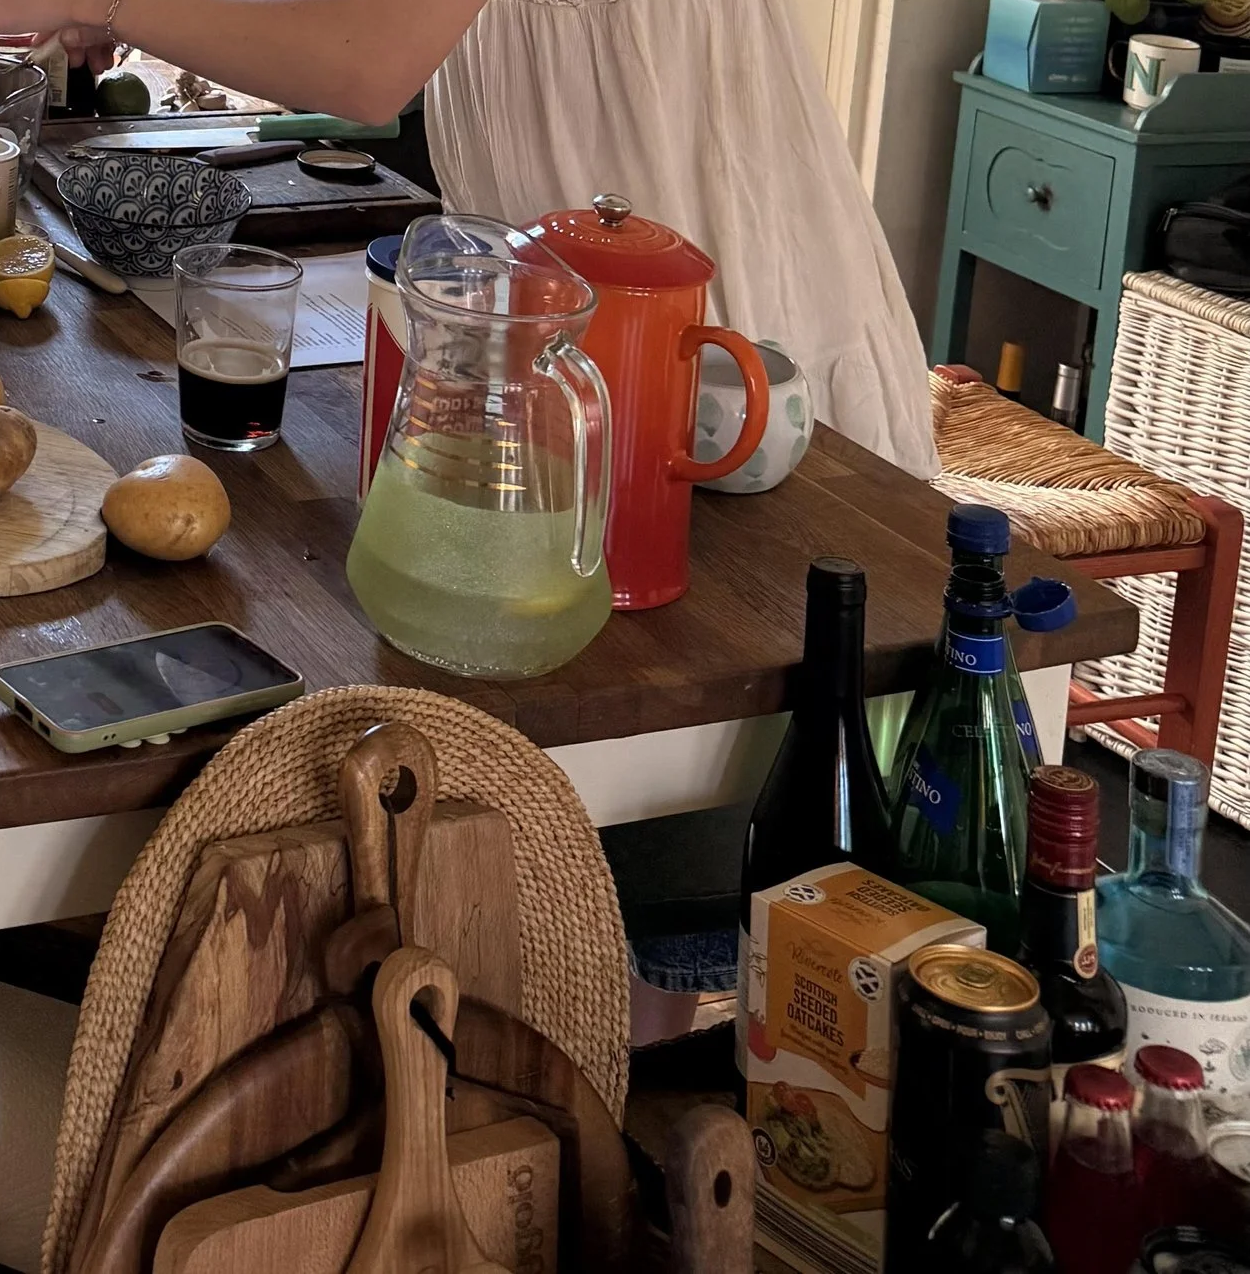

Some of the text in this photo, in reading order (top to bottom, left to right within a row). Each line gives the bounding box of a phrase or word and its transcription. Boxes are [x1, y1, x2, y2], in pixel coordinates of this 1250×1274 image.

[1127, 51, 1166, 97] N
[793, 987, 838, 1025] SEEDED
[794, 972, 838, 1007] SCOTTISH
[787, 1002, 845, 1047] OATCAKES
[1129, 1004, 1188, 1019] RODUCED
